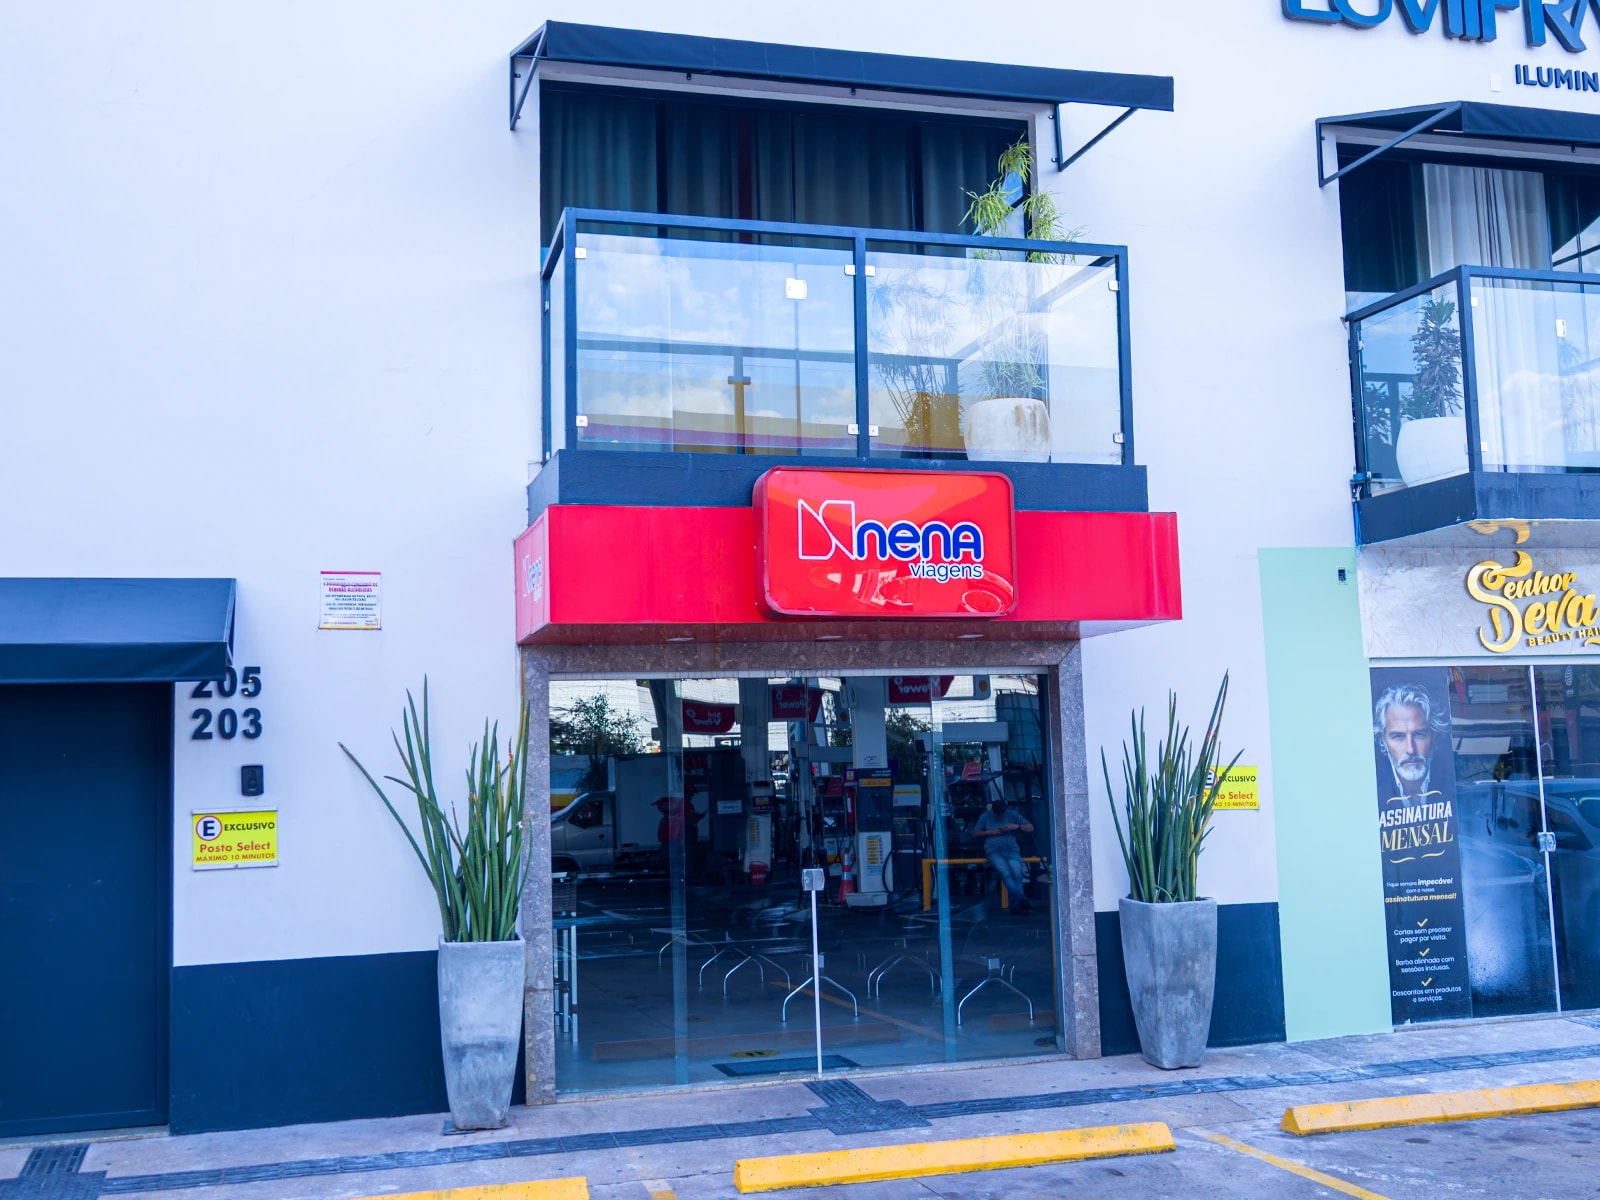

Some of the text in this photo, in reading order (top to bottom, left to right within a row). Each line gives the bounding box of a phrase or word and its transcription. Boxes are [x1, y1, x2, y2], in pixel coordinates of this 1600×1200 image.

[909, 561, 984, 582] viagens
[1467, 550, 1577, 632] Senhor
[1528, 627, 1600, 647] BEAUTY HAI
[192, 666, 262, 698] 205
[192, 708, 262, 739] 203
[1229, 791, 1253, 799] Select
[1380, 801, 1453, 828] ASSINATURA
[203, 820, 276, 836] E EXCLUSIVO
[1381, 821, 1454, 852] MENSAL
[199, 841, 272, 853] Posto Select
[241, 852, 276, 860] MINUTOS
[1418, 877, 1452, 887] impecável
[1428, 926, 1452, 934] precisar
[1400, 936, 1419, 944] pagar
[1419, 935, 1430, 943] por
[1395, 958, 1414, 966] Barba
[1392, 988, 1424, 997] Descontos
[1435, 985, 1462, 995] produtos
